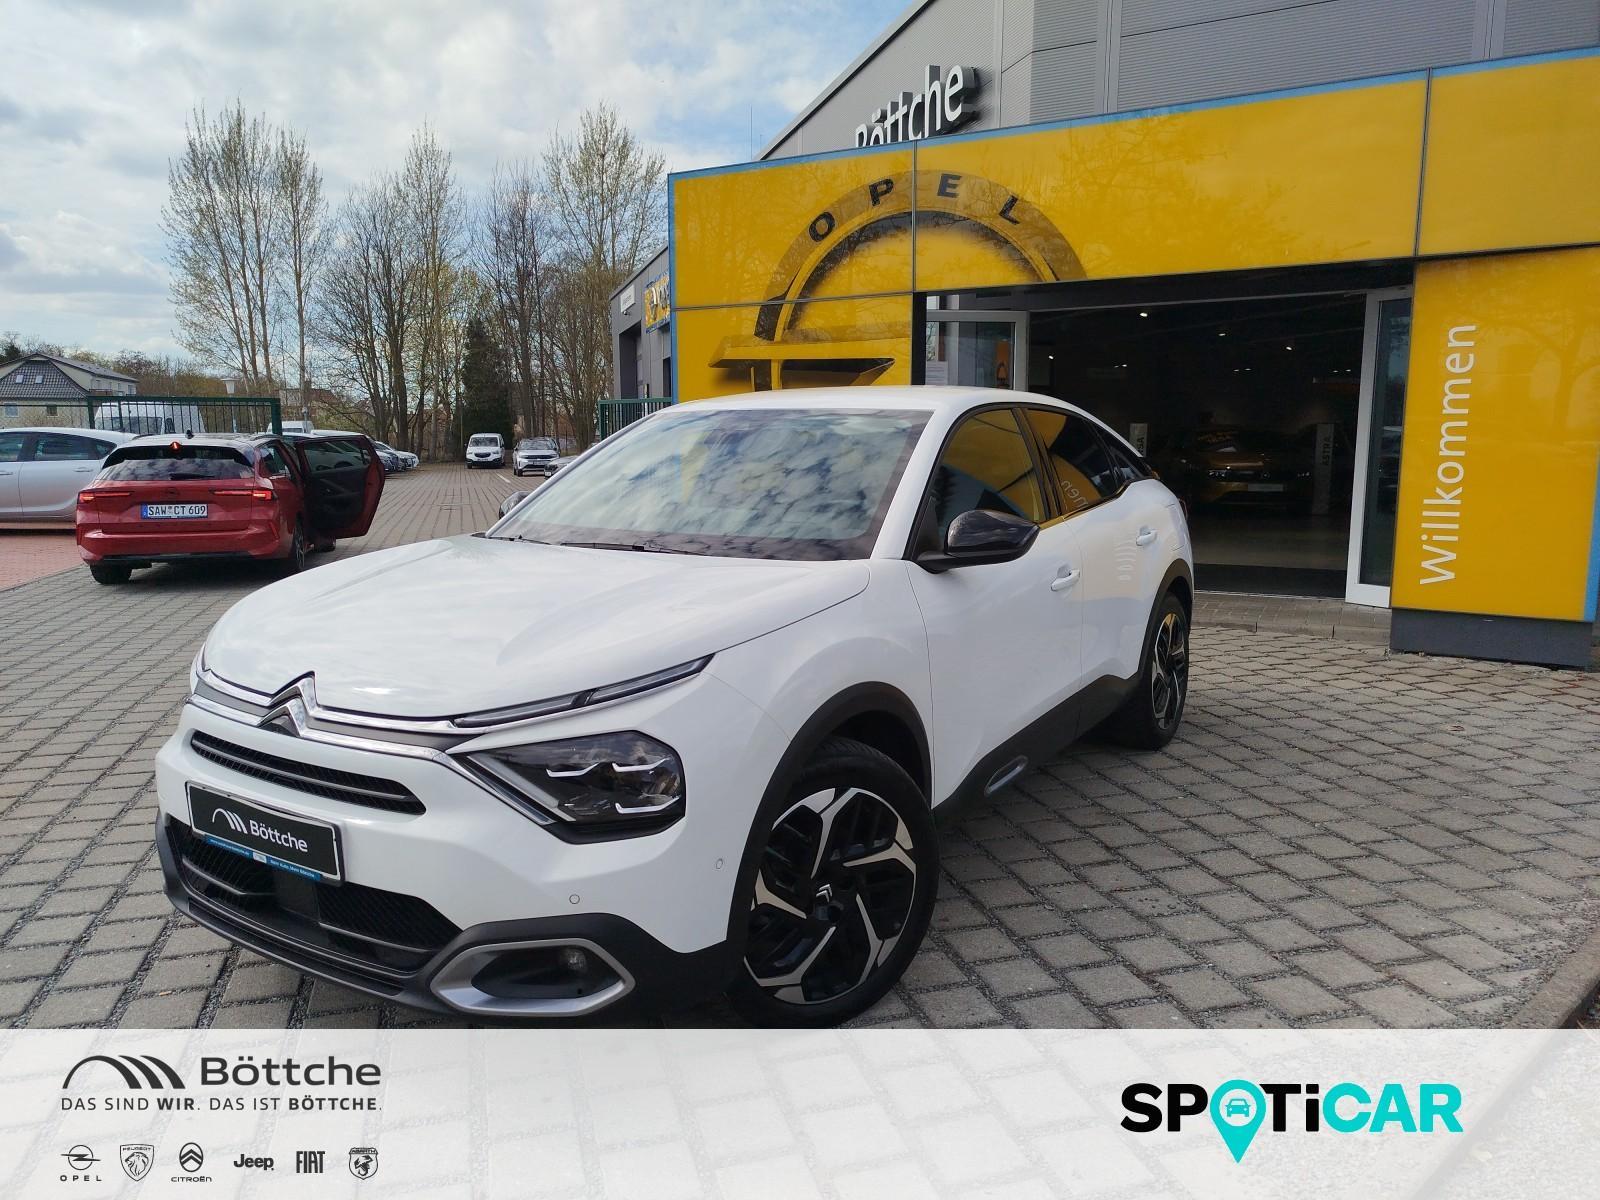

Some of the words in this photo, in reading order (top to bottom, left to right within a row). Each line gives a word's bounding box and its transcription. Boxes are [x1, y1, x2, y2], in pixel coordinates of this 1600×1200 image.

[808, 173, 1022, 243] OPEL
[1420, 325, 1477, 585] Willkommen
[148, 505, 167, 516] SAW
[173, 505, 186, 515] CT
[188, 505, 206, 515] 609
[249, 819, 308, 853] Böttche
